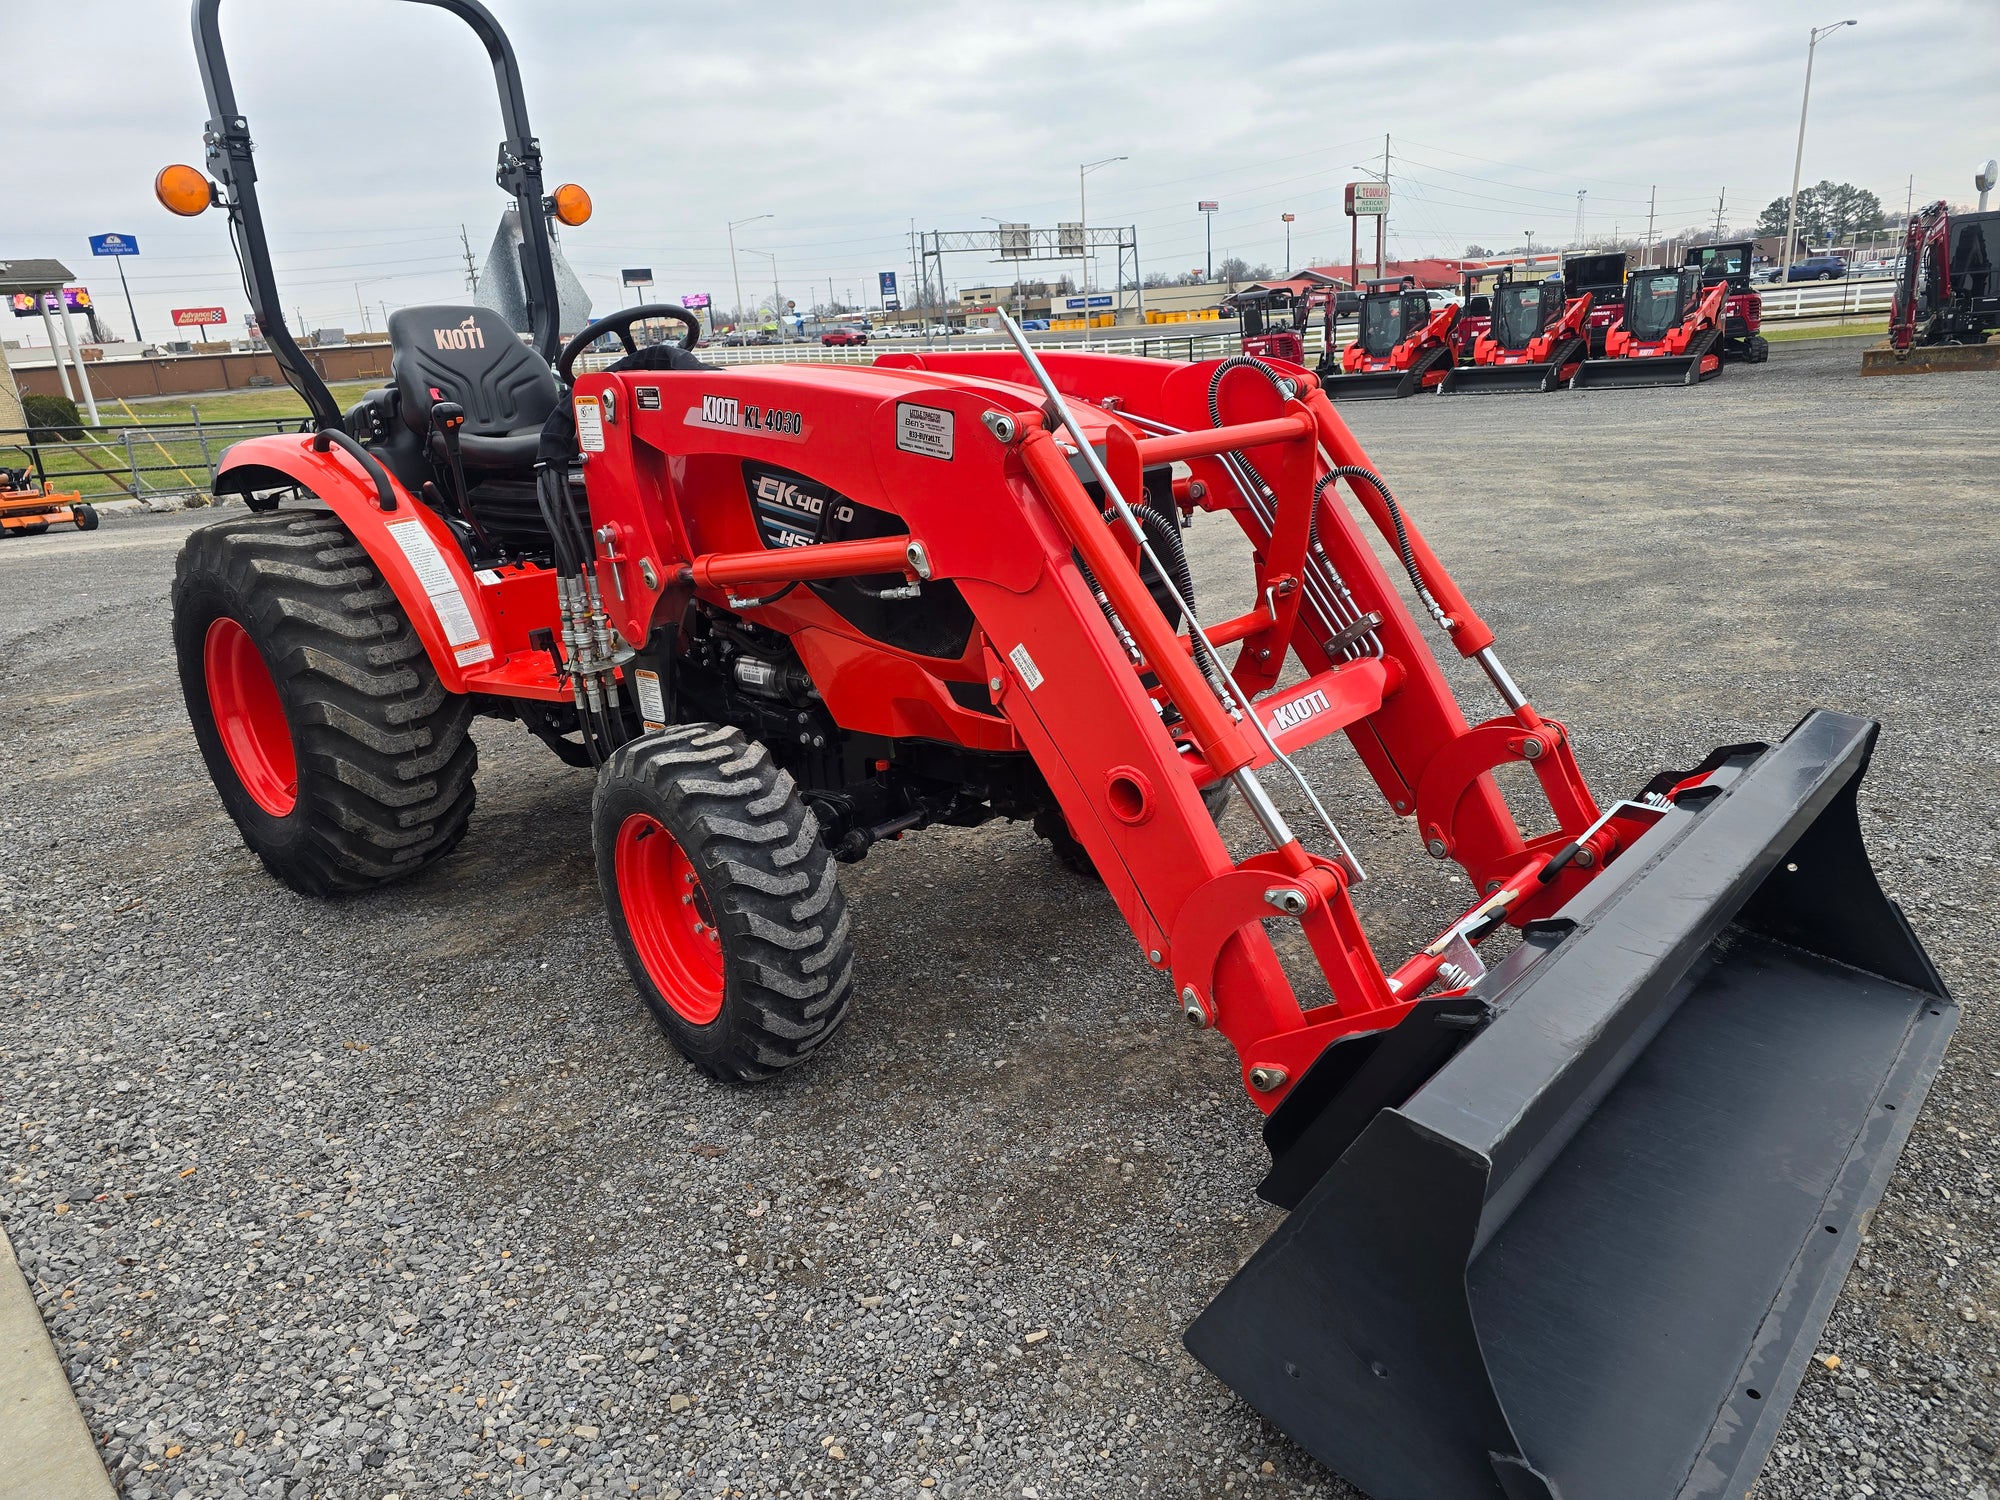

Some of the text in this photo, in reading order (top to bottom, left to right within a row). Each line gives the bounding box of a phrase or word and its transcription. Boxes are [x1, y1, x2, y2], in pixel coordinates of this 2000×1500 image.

[180, 311, 212, 319] Advance
[433, 327, 485, 350] KIOTI
[702, 394, 802, 436] KIOTI KL 4030
[923, 411, 941, 419] TRACTOR
[757, 476, 854, 523] CK400
[1271, 688, 1331, 731] KIOTI
